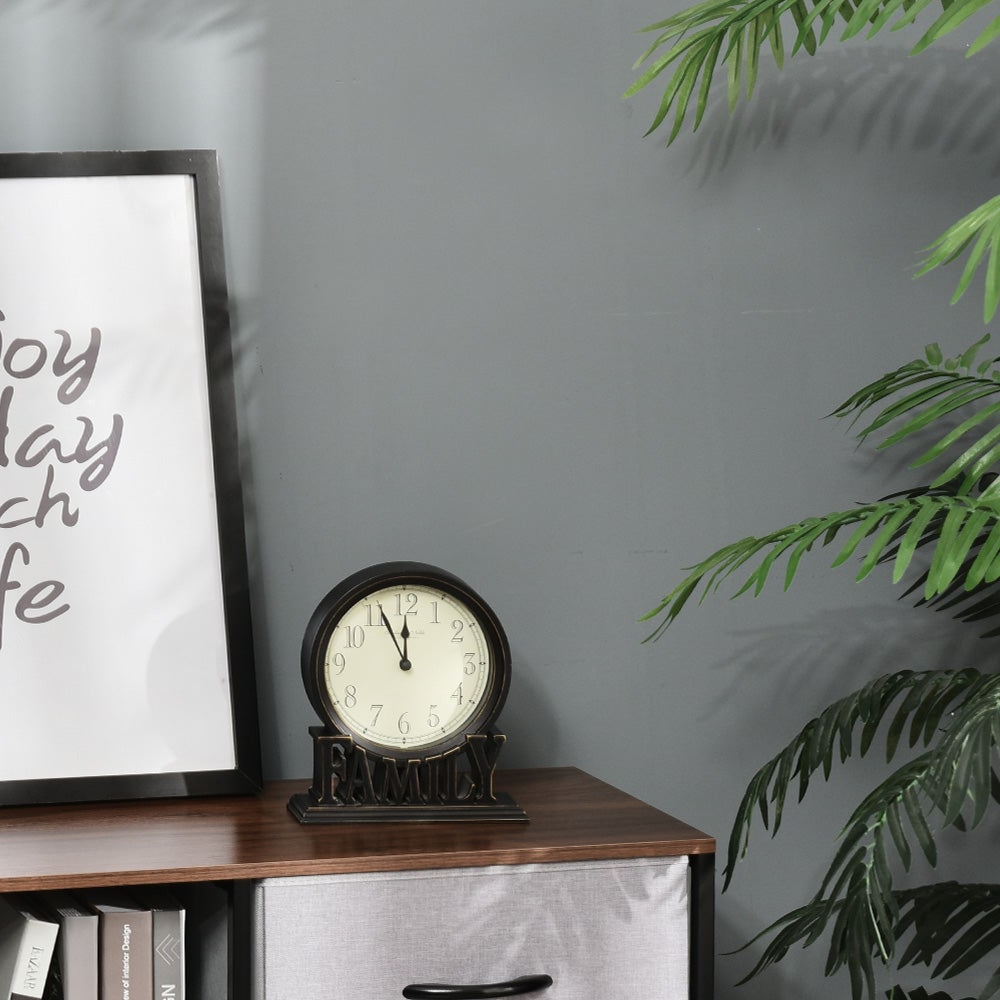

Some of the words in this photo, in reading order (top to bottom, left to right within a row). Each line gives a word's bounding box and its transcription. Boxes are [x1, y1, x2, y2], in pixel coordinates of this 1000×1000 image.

[364, 604, 386, 626] 11
[395, 593, 419, 615] 12
[430, 601, 440, 623] 1
[344, 625, 365, 648] 10
[451, 619, 464, 643] 2
[333, 653, 346, 675] 9
[463, 652, 476, 675] 3
[344, 684, 357, 708] 8
[451, 682, 463, 705] 4
[369, 705, 383, 726] 7
[398, 712, 410, 734] 6
[427, 705, 440, 727] 5
[316, 734, 507, 805] FAMILY
[121, 924, 132, 951] Design
[121, 979, 131, 989] of
